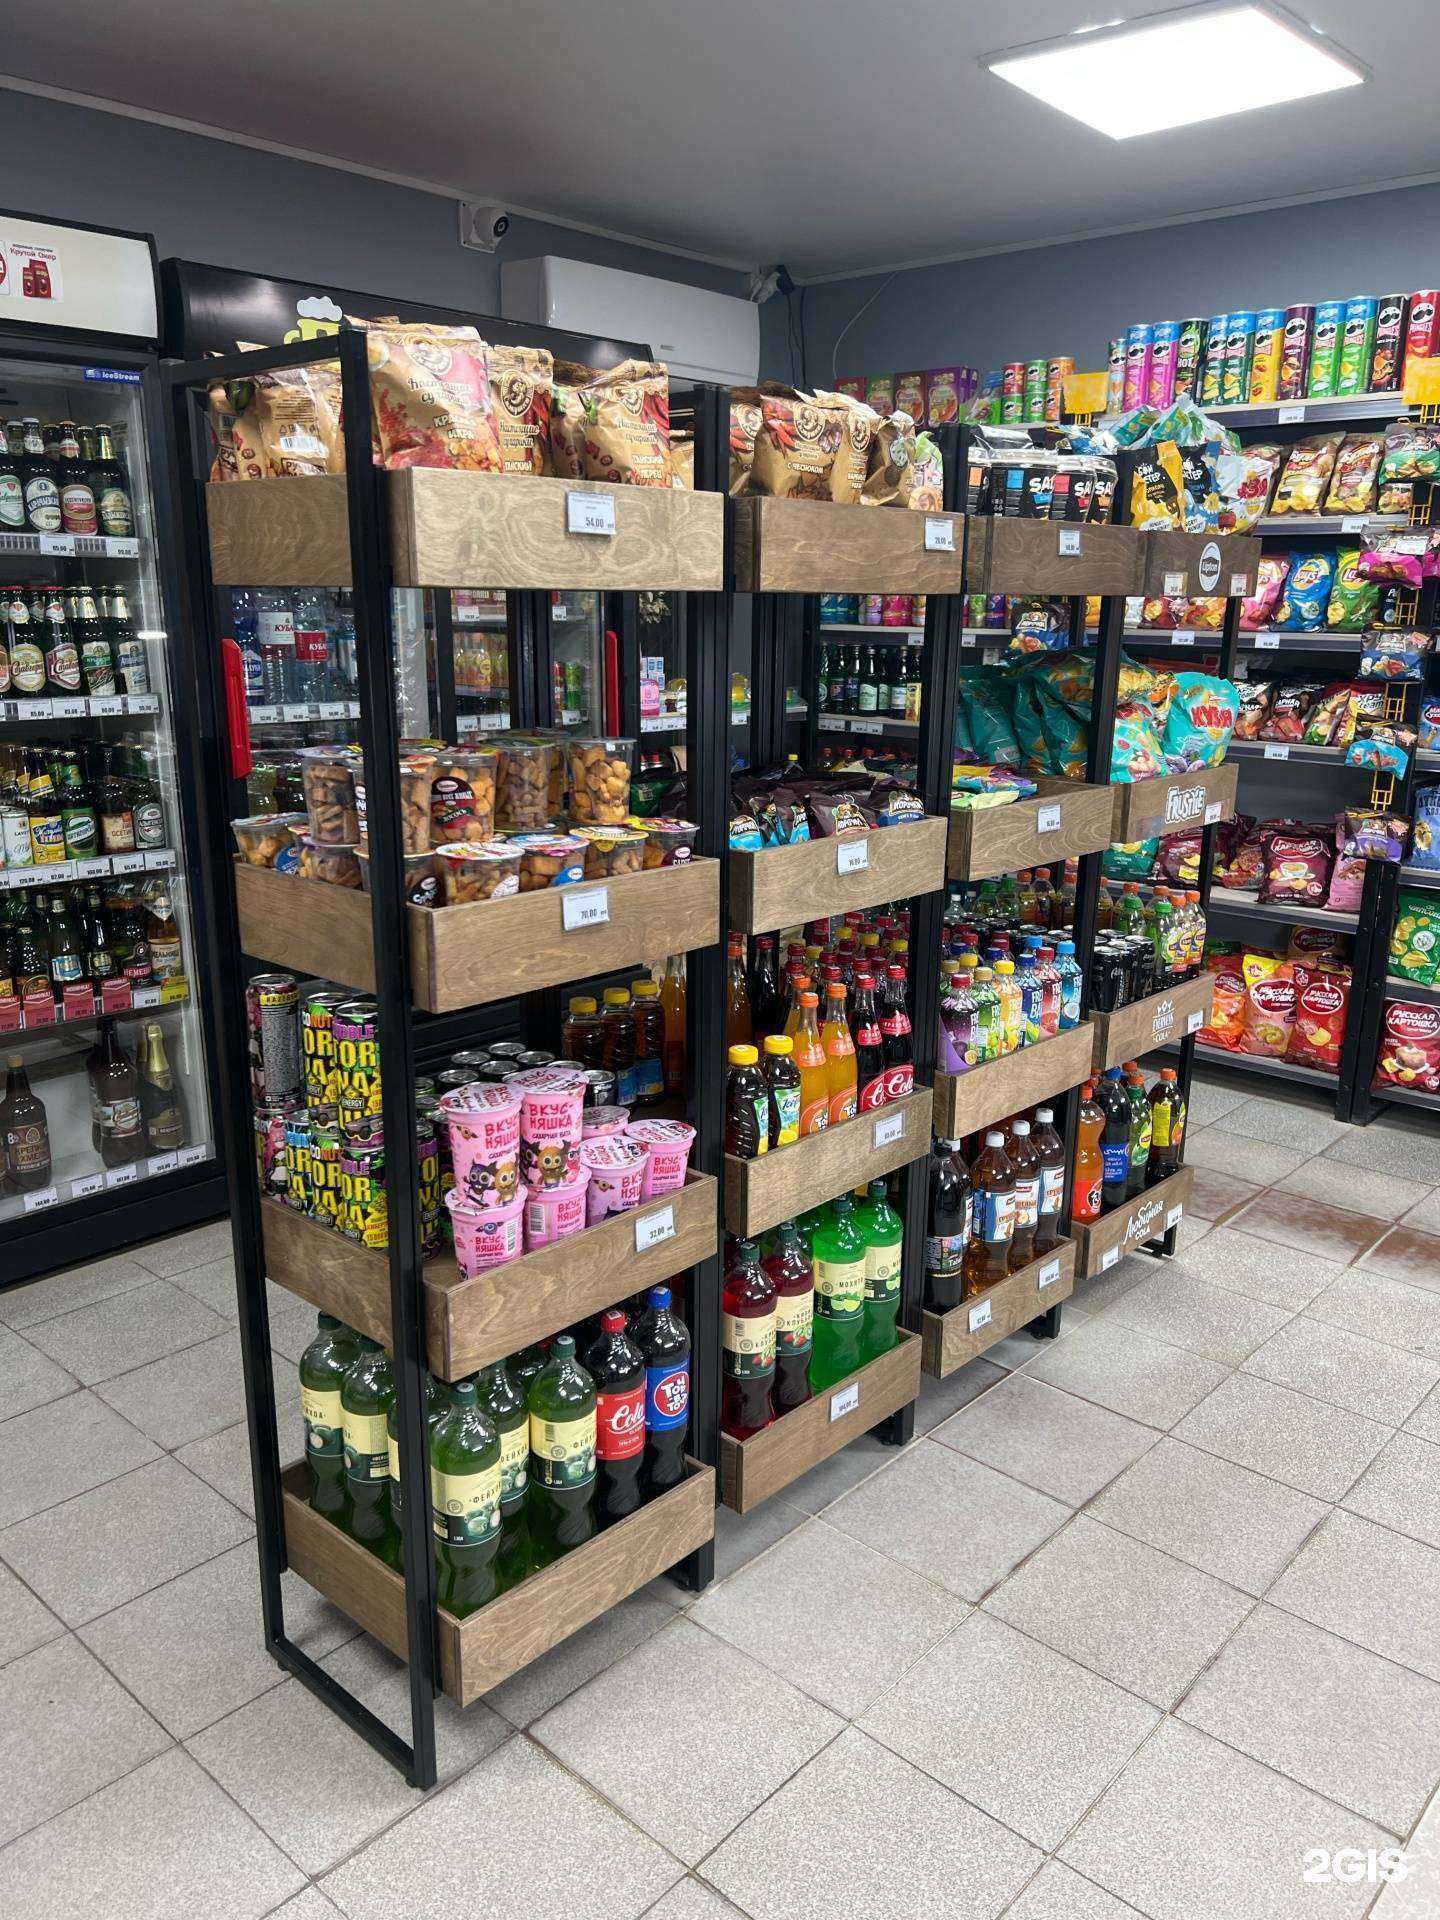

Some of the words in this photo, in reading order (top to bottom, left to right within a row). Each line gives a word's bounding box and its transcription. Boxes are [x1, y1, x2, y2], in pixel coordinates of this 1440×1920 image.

[102, 372, 140, 381] IceStream
[1392, 1009, 1435, 1021] РУССКАЯ
[1387, 1017, 1439, 1030] КАРТОШКА
[529, 1103, 573, 1117] ВКУС-
[529, 1116, 573, 1130] НЯШКА
[653, 1164, 681, 1175] НЯШКА
[475, 1244, 505, 1253] НЯШКА
